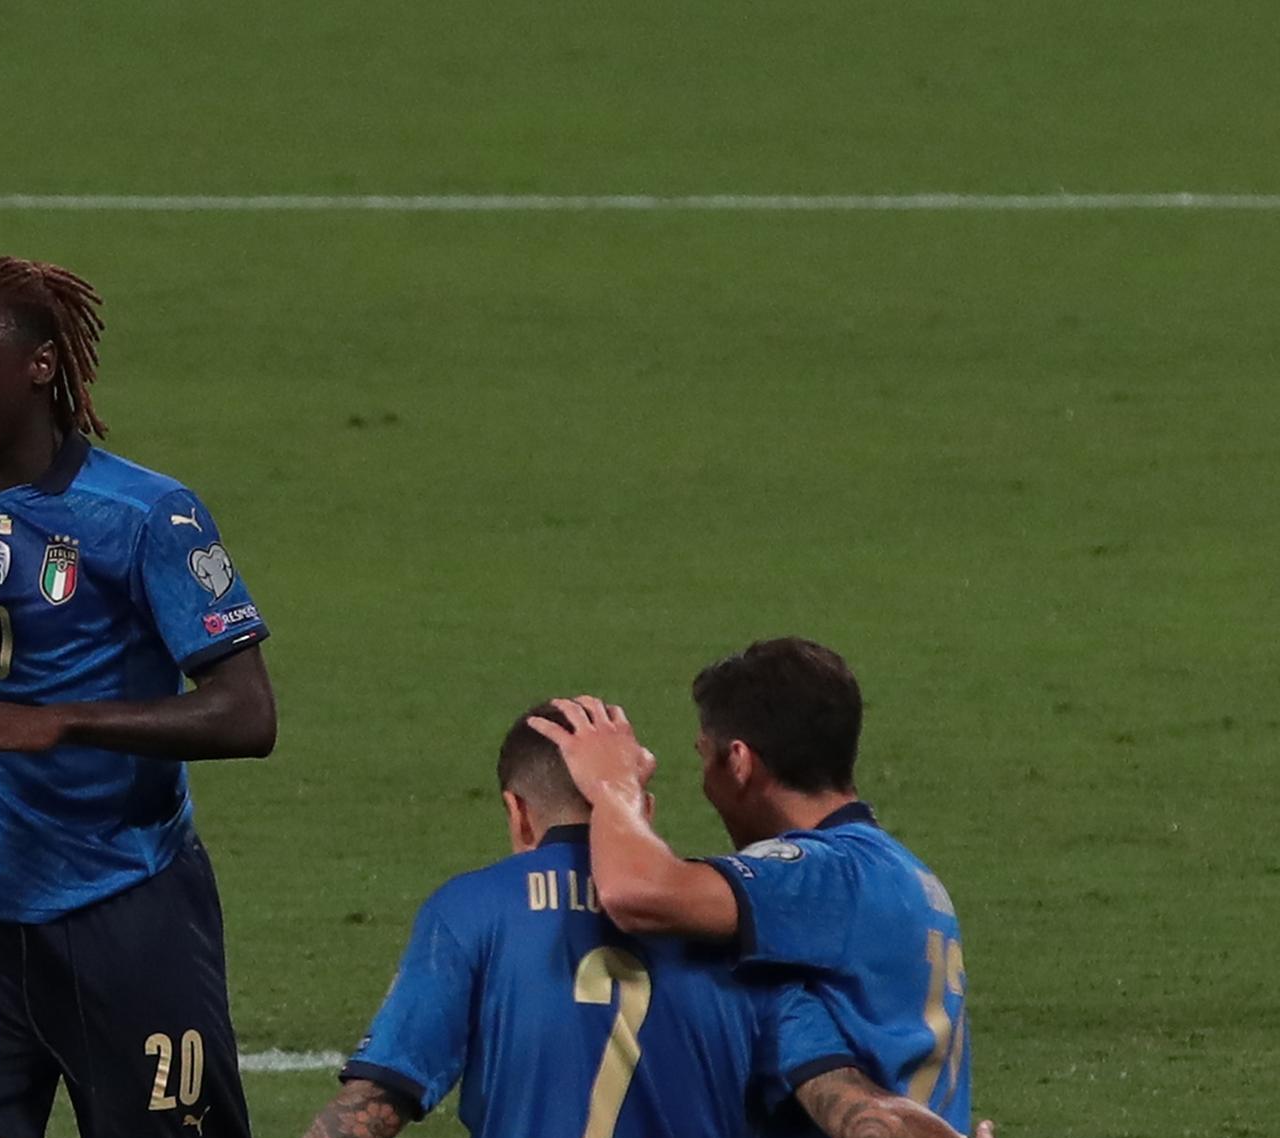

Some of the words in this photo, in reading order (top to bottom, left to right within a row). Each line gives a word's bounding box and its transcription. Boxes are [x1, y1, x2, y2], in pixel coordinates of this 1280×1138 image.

[527, 870, 559, 911] DI
[569, 869, 603, 914] LO
[144, 1029, 204, 1111] 20
